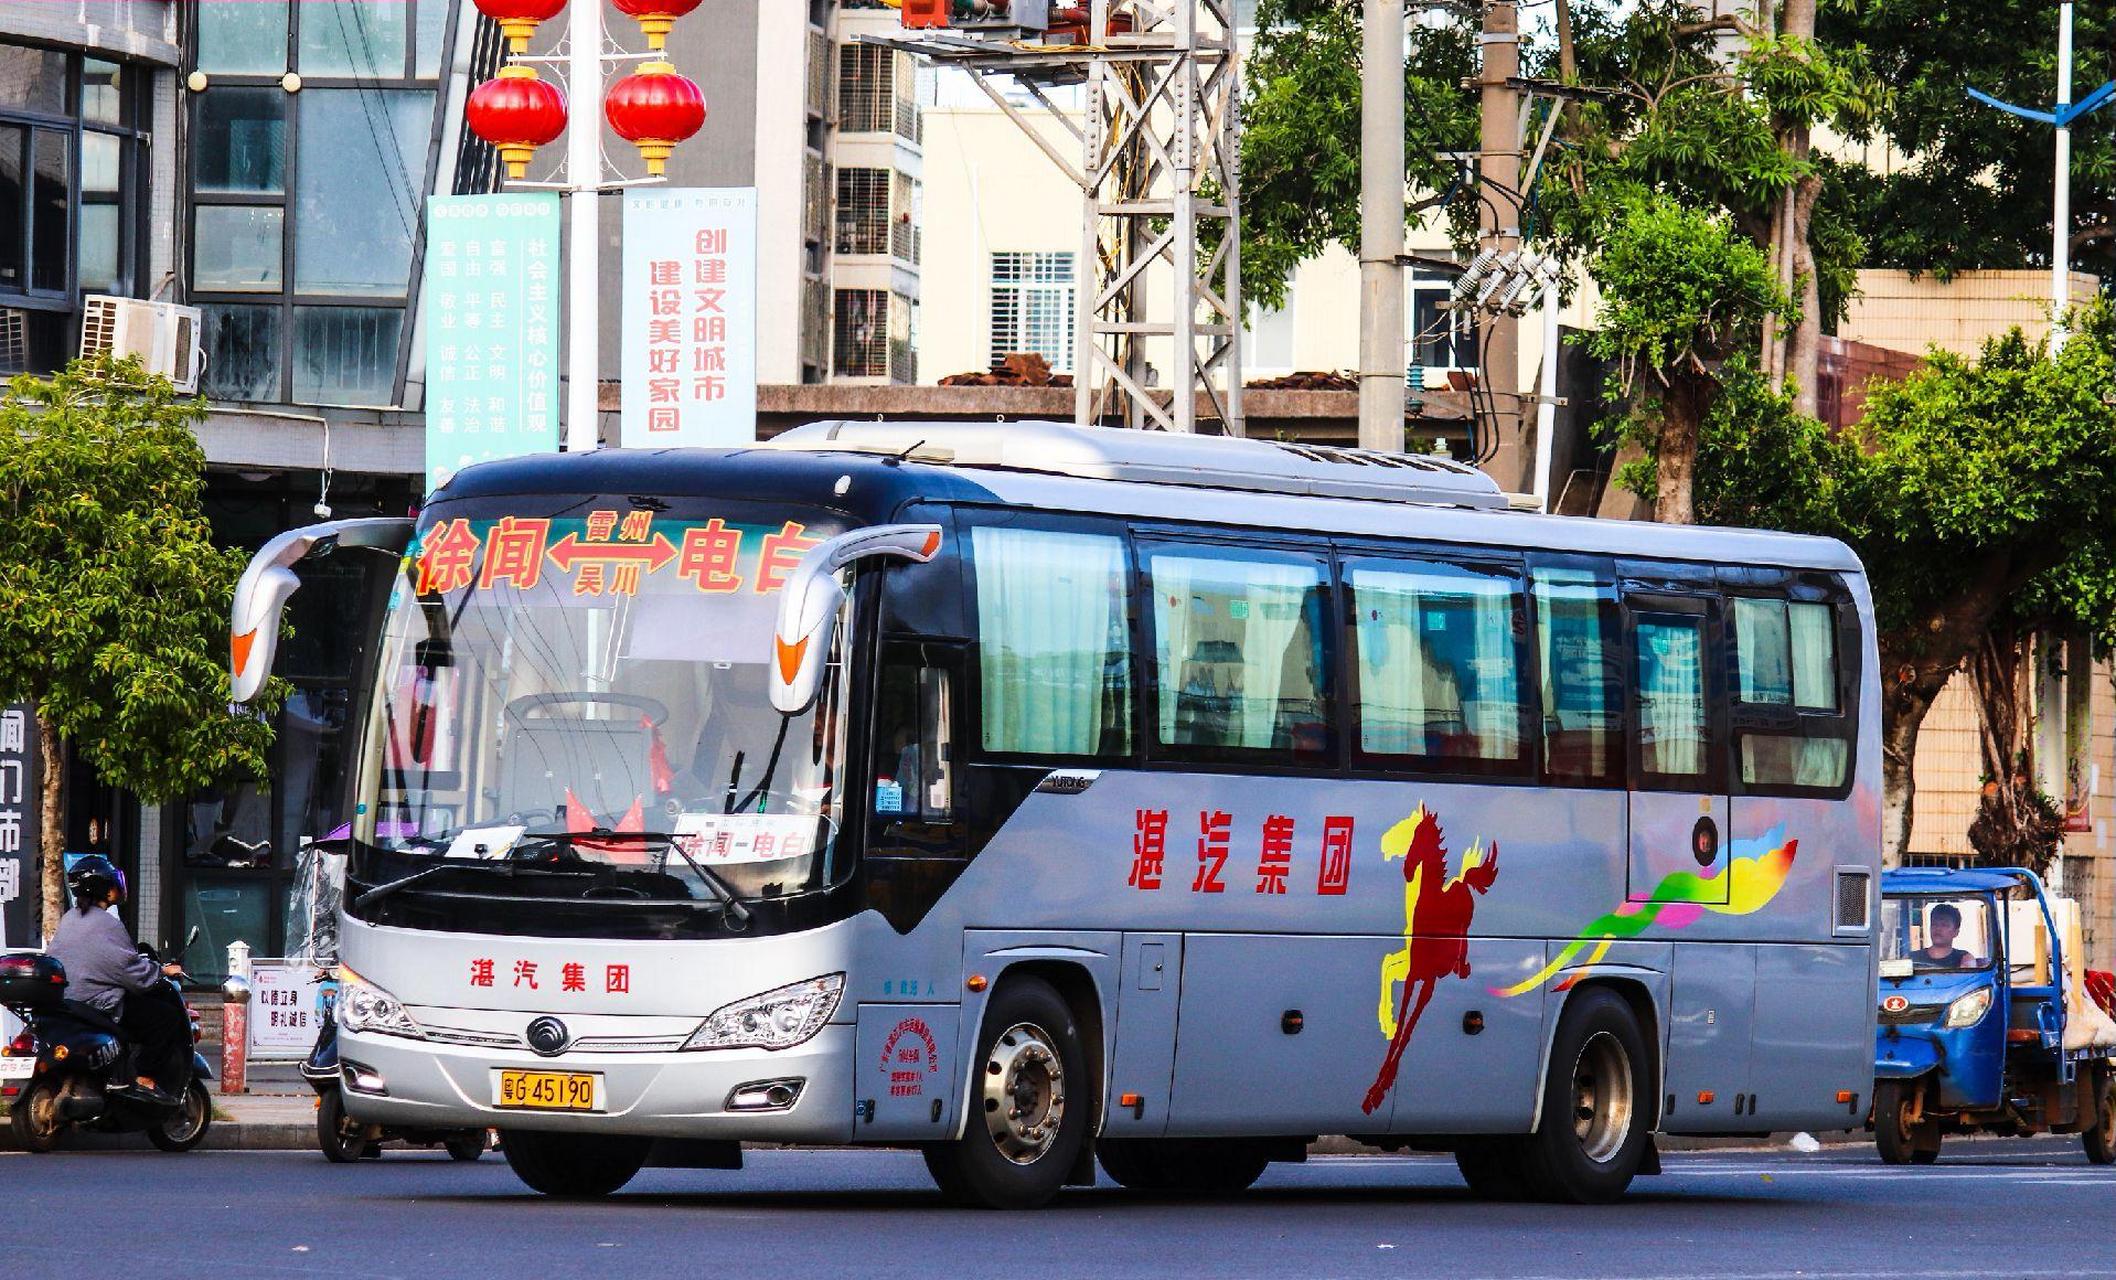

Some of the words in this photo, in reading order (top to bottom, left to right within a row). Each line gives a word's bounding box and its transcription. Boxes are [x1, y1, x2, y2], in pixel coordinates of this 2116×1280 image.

[464, 240, 481, 277] 自由
[489, 292, 507, 329] 民主
[693, 228, 727, 402] 创建文明城市
[527, 238, 548, 433] 社会主义核心价值观
[648, 260, 682, 433] 建设美好家园
[464, 344, 481, 381] 公正
[489, 344, 507, 381] 文明
[464, 397, 481, 433] 法治
[587, 510, 654, 542] 雷州
[416, 516, 551, 596] 徐闻
[573, 563, 642, 596] 吴川
[1052, 775, 1086, 788] YUTONG
[1128, 807, 1355, 896] 湛汽集团
[470, 958, 630, 993] 湛汽集团
[261, 990, 298, 1006] 以德立身
